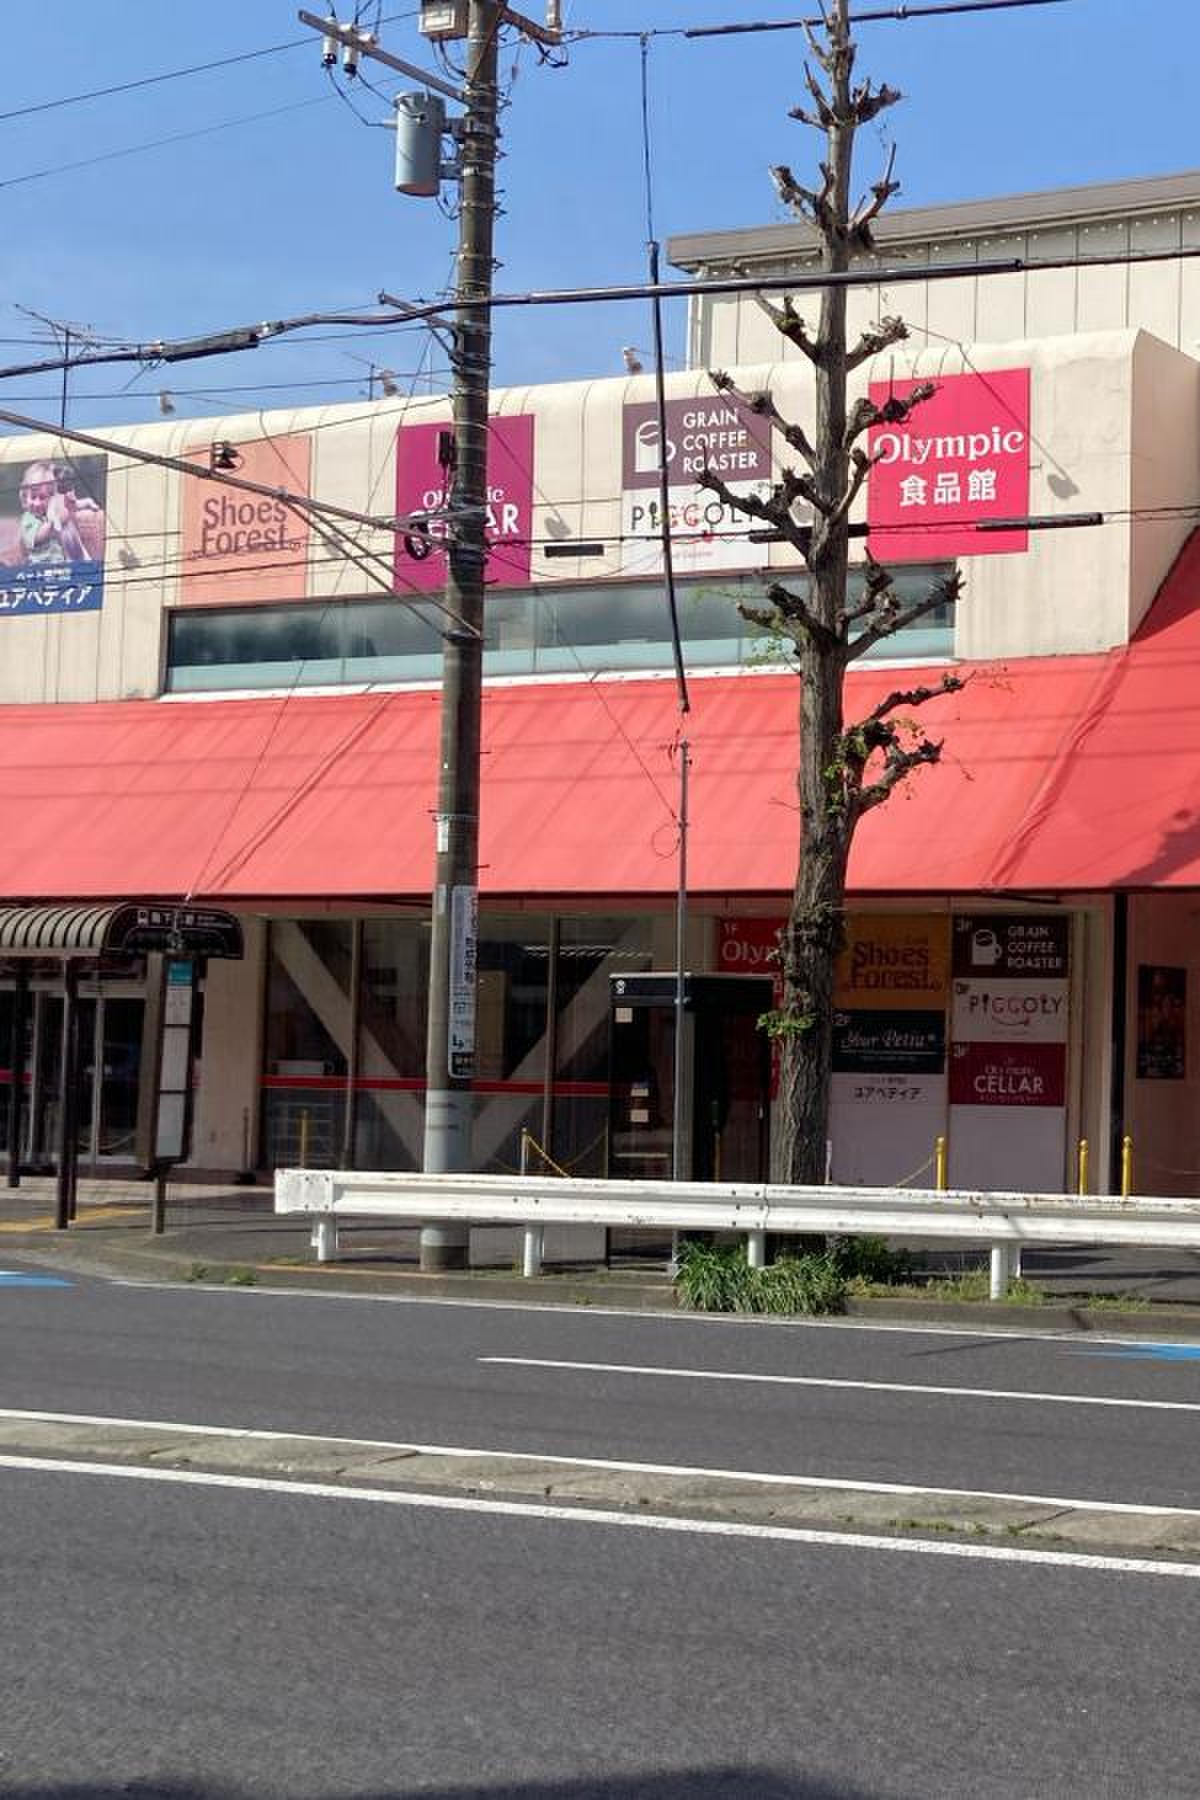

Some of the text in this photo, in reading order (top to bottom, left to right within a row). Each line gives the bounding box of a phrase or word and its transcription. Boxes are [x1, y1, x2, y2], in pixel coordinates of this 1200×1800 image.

[683, 408, 739, 428] GRAIN
[683, 430, 748, 451] COFFEE
[873, 426, 1024, 465] Olympic
[682, 451, 758, 474] ROASTER
[899, 469, 998, 507] 食品館
[204, 496, 288, 529] Shoes
[202, 524, 290, 555] Forest
[1007, 926, 1050, 938] GRAIN
[853, 940, 929, 967] Shoes
[1007, 941, 1055, 954] COFFEE
[1007, 956, 1062, 969] ROASTER
[850, 964, 930, 990] Forest
[973, 1074, 1045, 1095] CELLAR
